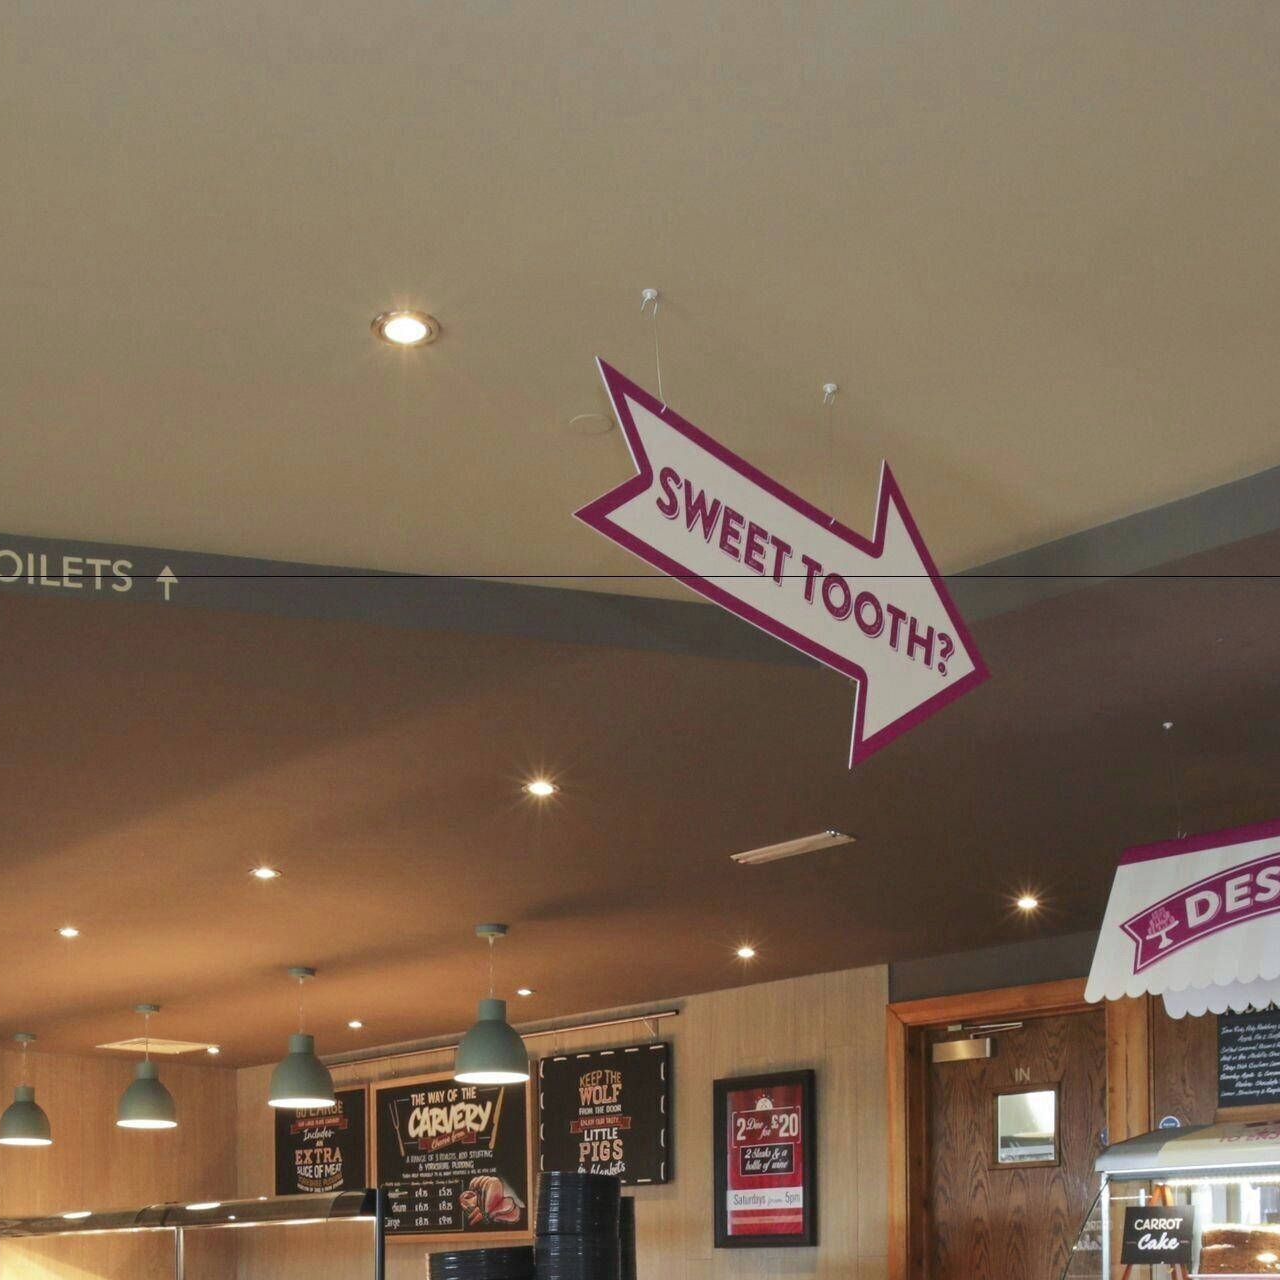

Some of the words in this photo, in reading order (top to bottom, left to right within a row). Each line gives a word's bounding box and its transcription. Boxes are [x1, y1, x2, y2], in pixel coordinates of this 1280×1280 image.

[656, 466, 792, 587] SWEET
[802, 554, 955, 677] TOOTH?
[579, 1070, 602, 1087] KEEP
[605, 1069, 621, 1084] THE
[1015, 1067, 1030, 1081] IN
[410, 1094, 425, 1106] THE
[428, 1091, 445, 1103] WAY
[447, 1089, 458, 1102] OF
[461, 1086, 477, 1100] THE
[579, 1083, 622, 1106] WOLF
[579, 1107, 594, 1116] FROM
[595, 1106, 604, 1114] THE
[606, 1104, 622, 1113] DOOR
[408, 1100, 492, 1138] CARVERY
[736, 1118, 746, 1141] 2
[771, 1113, 799, 1137] £20
[303, 1126, 334, 1141] Includes
[584, 1127, 618, 1142] LITTLE
[295, 1147, 342, 1165] EXTRA
[579, 1139, 624, 1162] PIGS
[744, 1149, 751, 1159] 2
[752, 1147, 771, 1158] Steaks
[772, 1148, 780, 1159] &
[297, 1166, 313, 1178] SLICE
[314, 1164, 323, 1178] OF
[325, 1163, 342, 1177] MEAT
[578, 1163, 586, 1174] in
[590, 1160, 626, 1176] blankets
[745, 1159, 761, 1171] bottle
[763, 1158, 773, 1172] of
[772, 1160, 789, 1169] wine
[733, 1194, 766, 1207] Saturdays
[1134, 1218, 1183, 1231] CARROT
[1137, 1232, 1180, 1250] Cake
